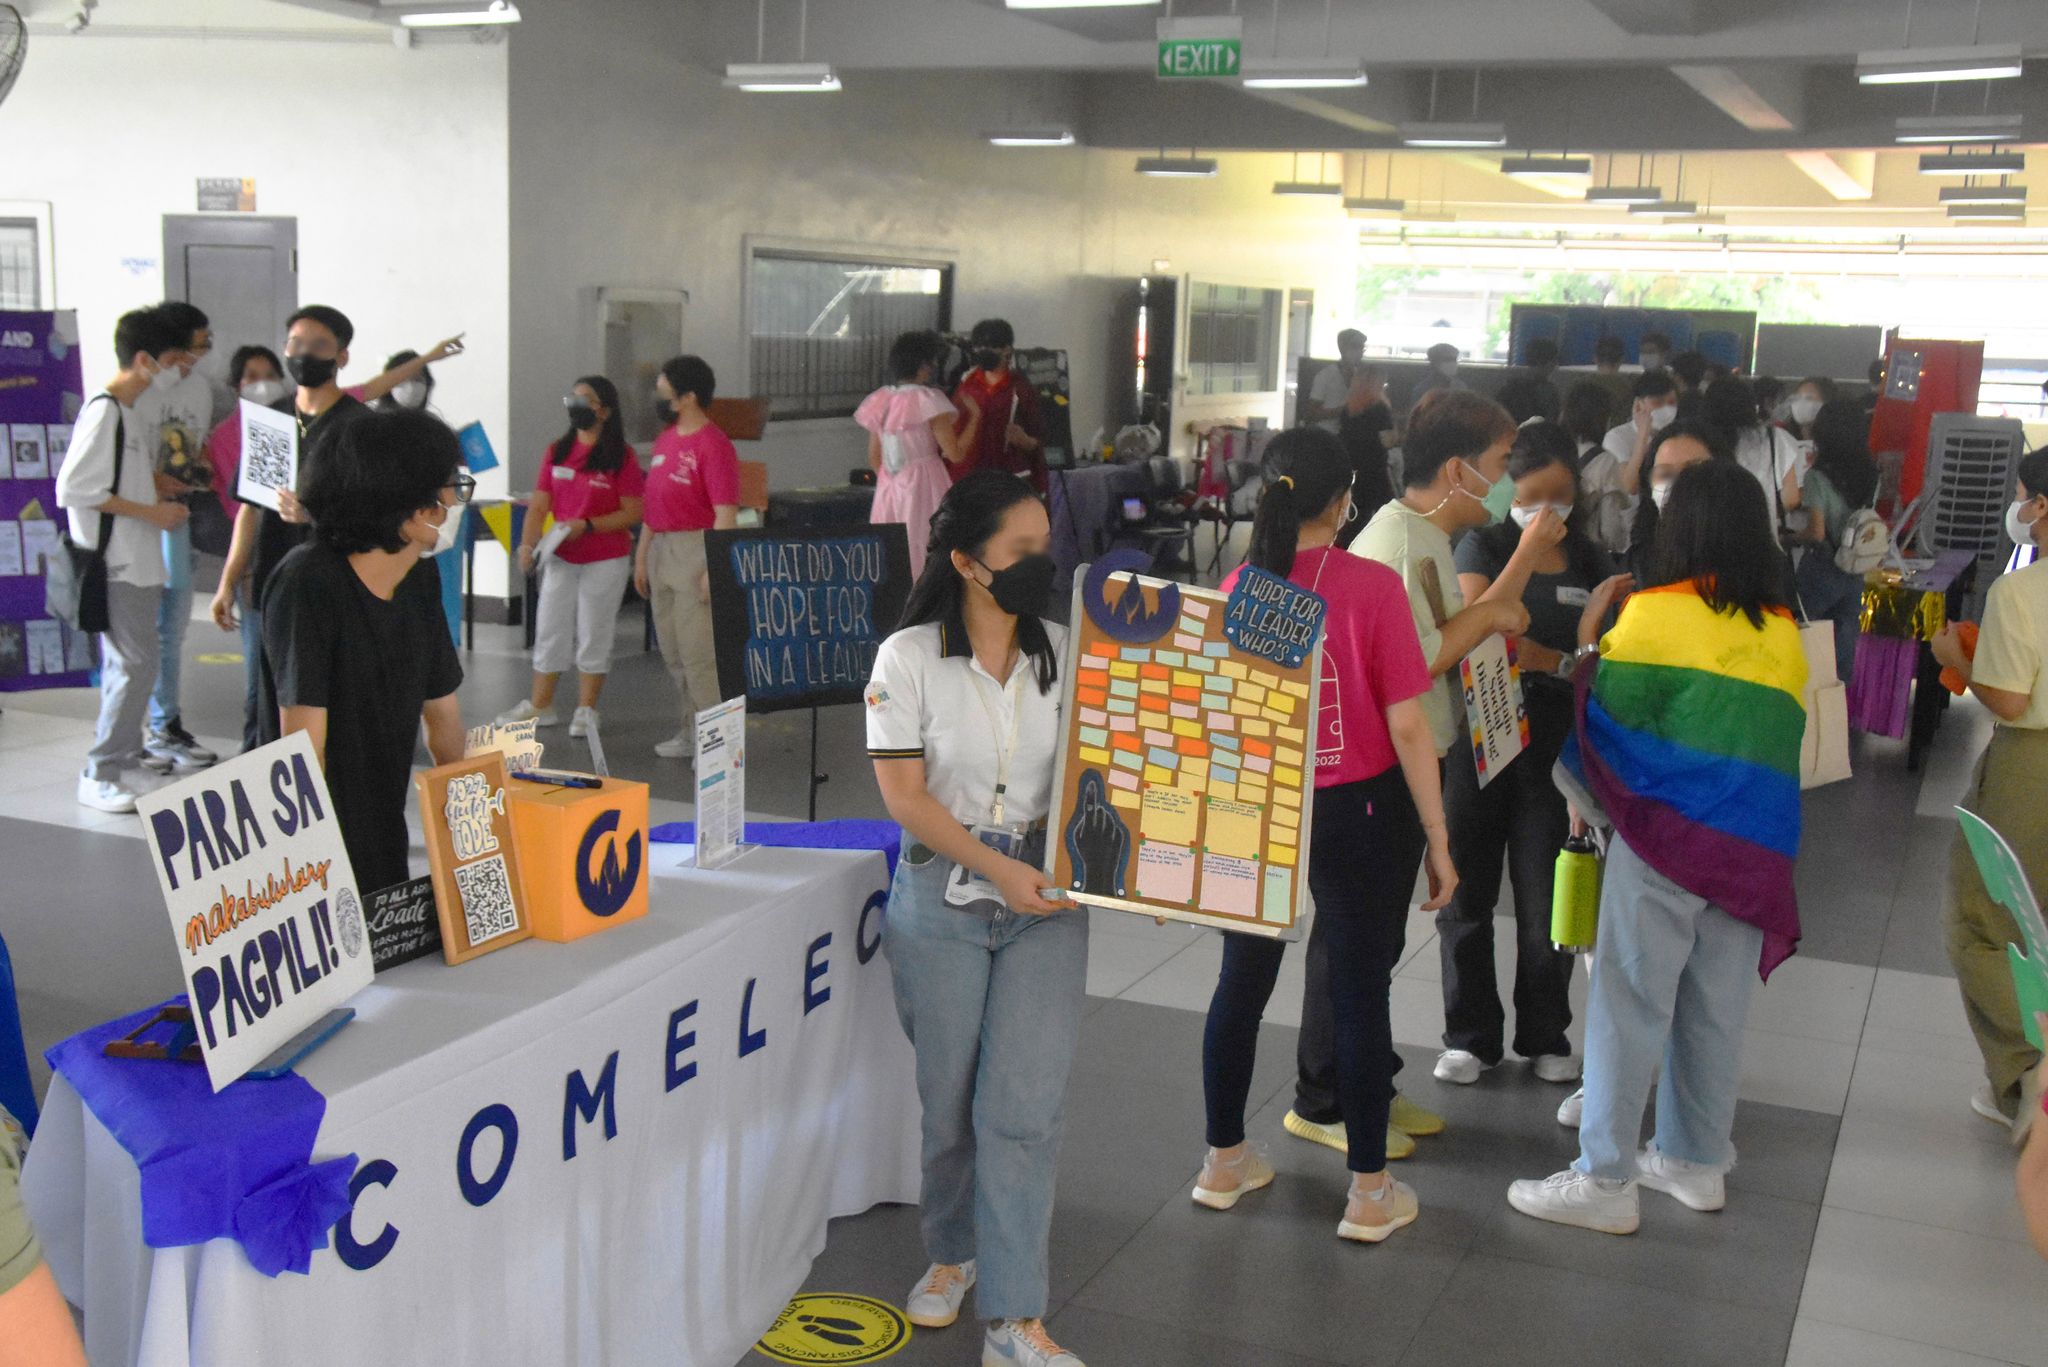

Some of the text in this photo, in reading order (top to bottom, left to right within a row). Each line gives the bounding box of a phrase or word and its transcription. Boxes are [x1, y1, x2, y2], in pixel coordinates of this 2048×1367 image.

[1175, 44, 1223, 73] EXIT
[1, 330, 34, 348] AND
[734, 542, 880, 584] WHAT DO YOU
[752, 586, 869, 640] HOPE FOR
[1230, 599, 1312, 649] A LEADER
[1242, 571, 1322, 625] I HOPE FOR
[749, 646, 773, 688] IN
[782, 645, 796, 684] A
[1490, 676, 1505, 731] Social
[1495, 657, 1512, 736] Maintain
[464, 724, 495, 750] PARA
[1314, 754, 1341, 766] 2022
[150, 752, 325, 891] PARA SA
[453, 819, 497, 858] CODE
[185, 857, 332, 956] makabuluhang
[375, 893, 388, 909] TO
[389, 887, 408, 904] ALL
[192, 899, 339, 1050] PAGPILI!
[334, 888, 889, 1271] COMELEC
[774, 1299, 894, 1358] OBSERVE PHYSICAL DISTANCING
